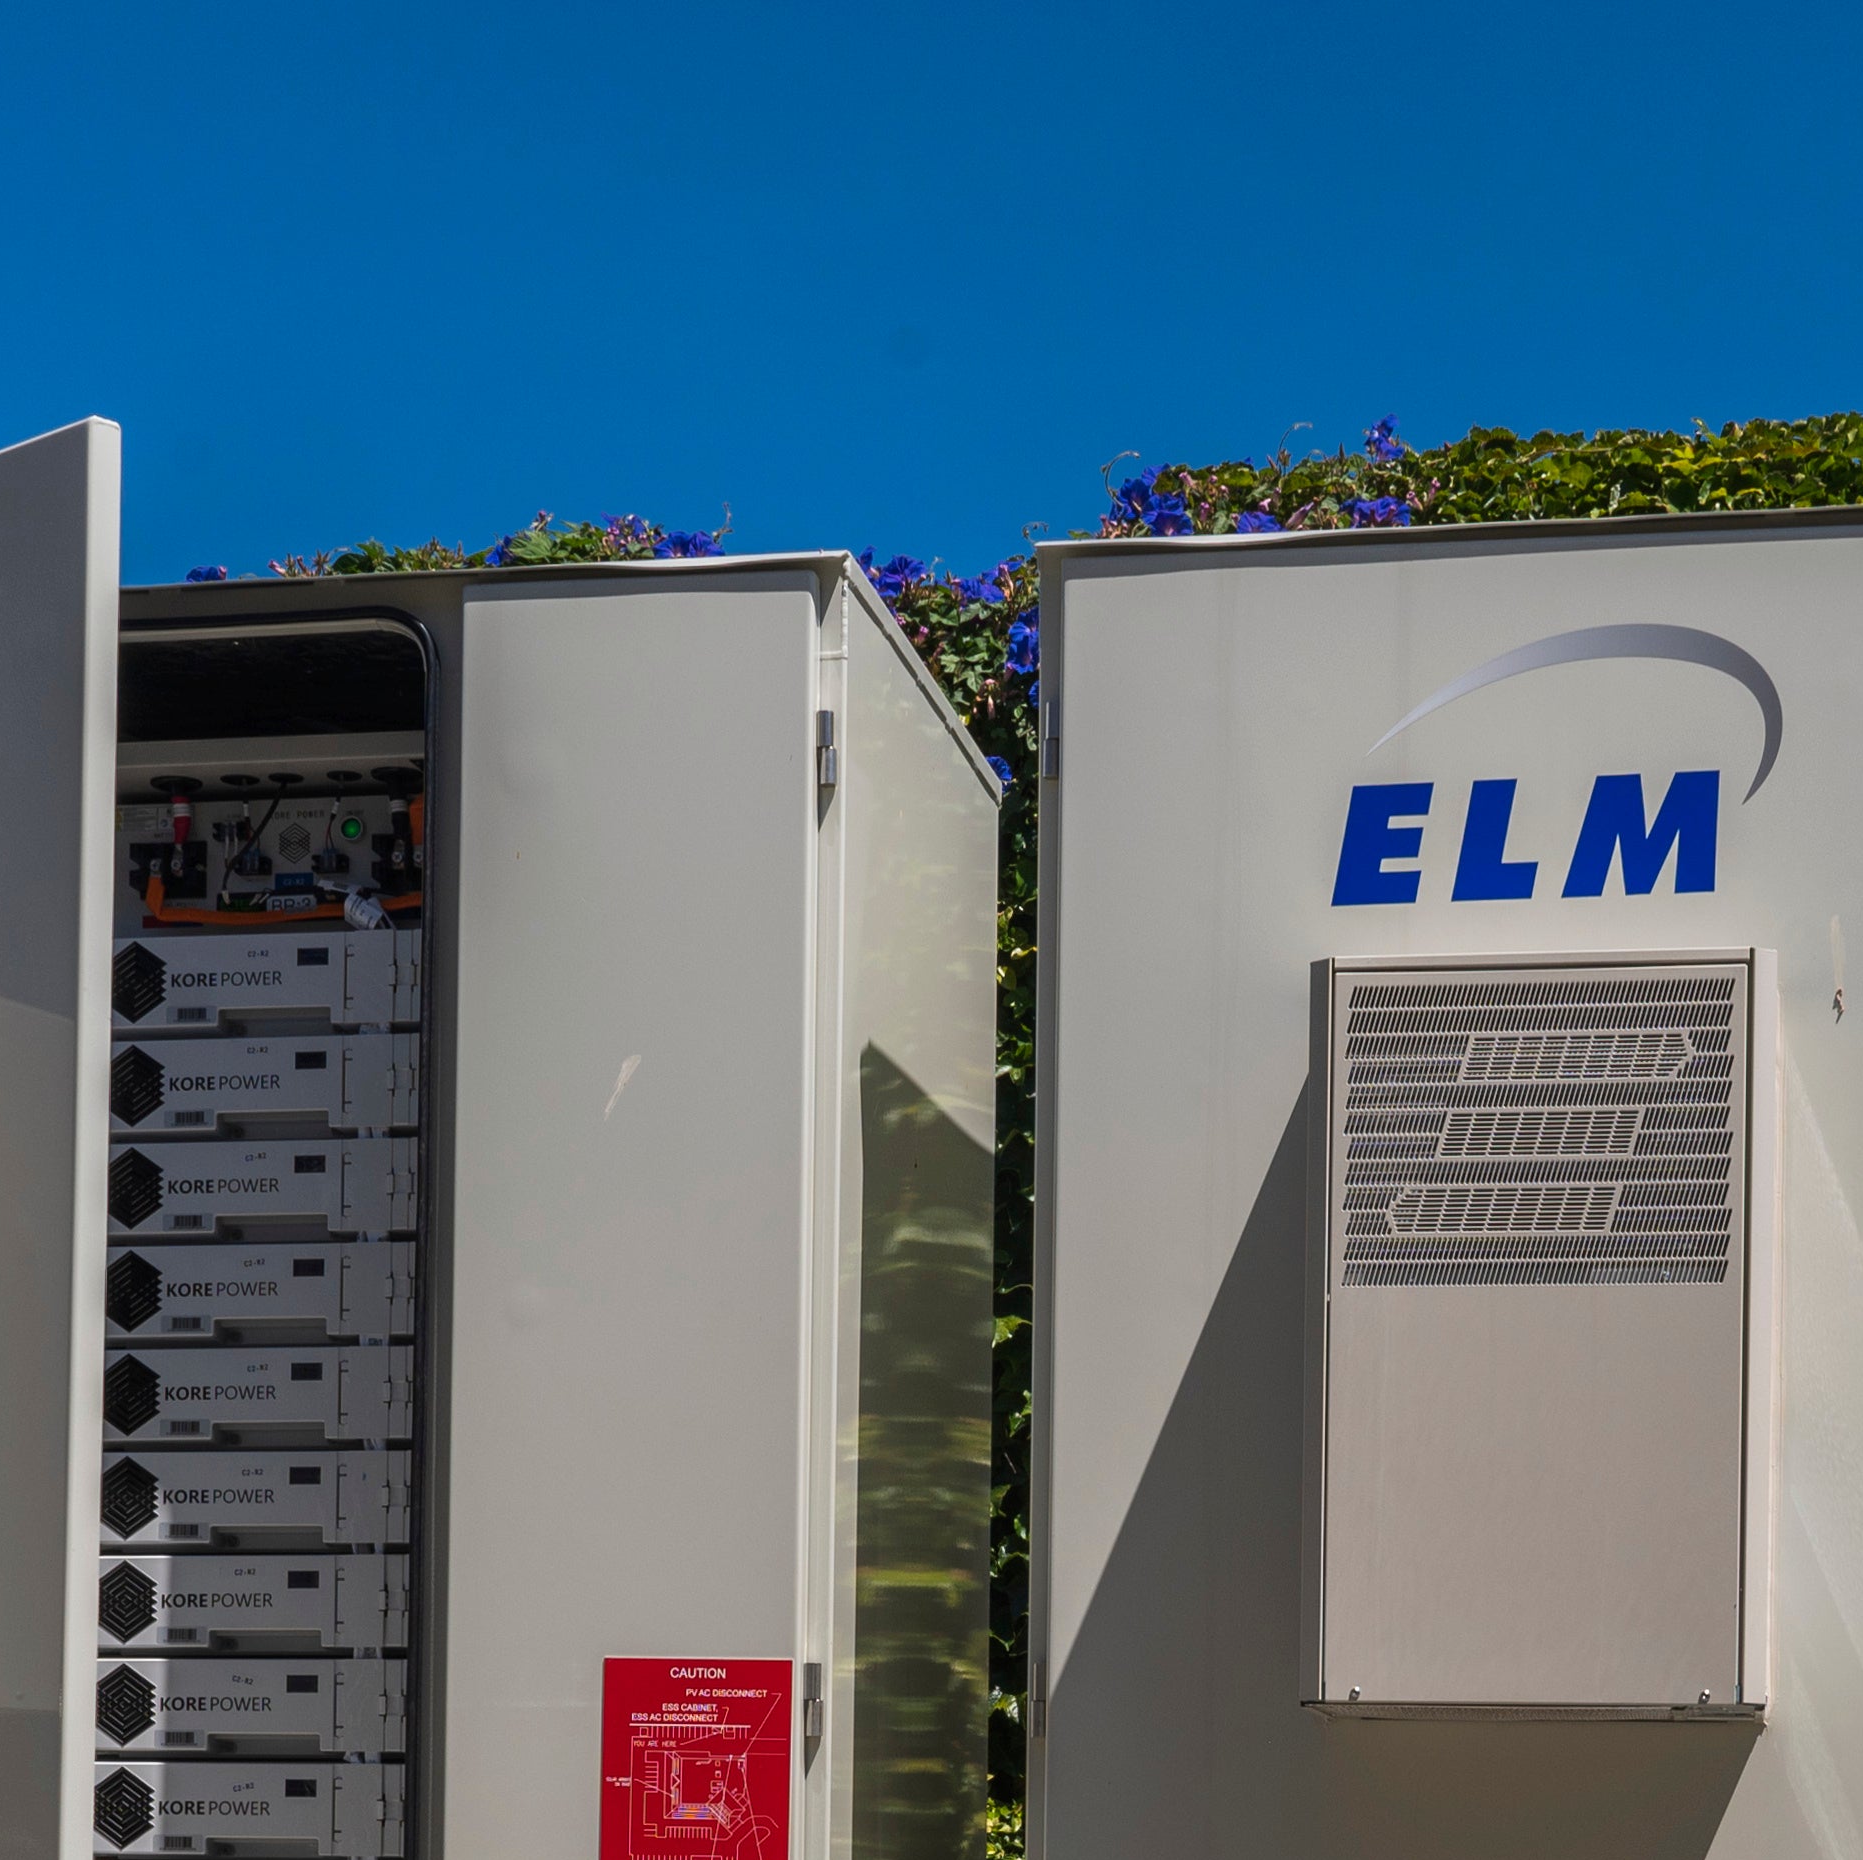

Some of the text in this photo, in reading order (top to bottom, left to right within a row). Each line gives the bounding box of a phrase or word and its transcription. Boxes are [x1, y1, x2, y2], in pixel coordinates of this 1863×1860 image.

[1331, 770, 1720, 907] ELM
[669, 1666, 727, 1679] CAUTION
[685, 1688, 768, 1698] PV AC DISCONNECT
[661, 1703, 680, 1712] ESS
[631, 1712, 719, 1722] ESS AC DISCONNECT
[633, 1740, 678, 1748] YOU ARE HERE
